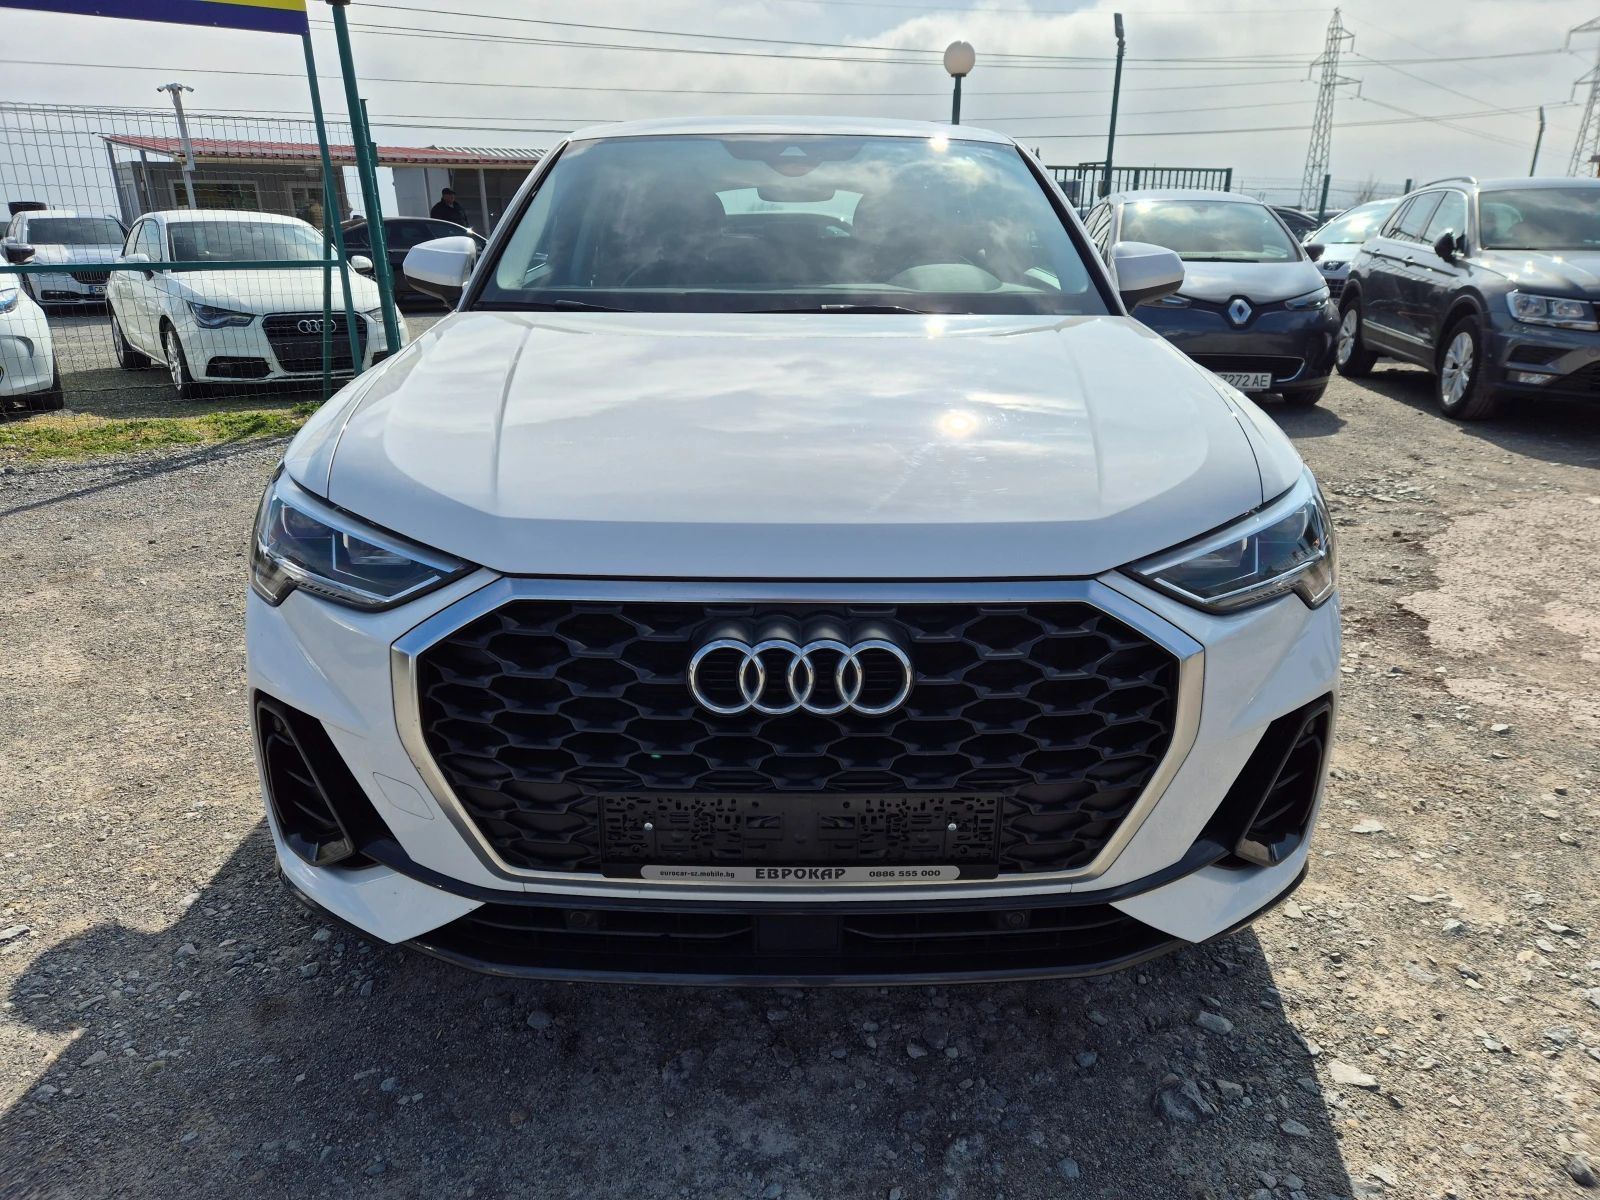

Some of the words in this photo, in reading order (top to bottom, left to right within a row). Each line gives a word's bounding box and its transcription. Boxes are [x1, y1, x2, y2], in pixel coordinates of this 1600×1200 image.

[1251, 374, 1269, 387] AE
[660, 870, 735, 878] eurocar-sz.mobile.bg
[755, 868, 846, 881] ЕВРОКАР
